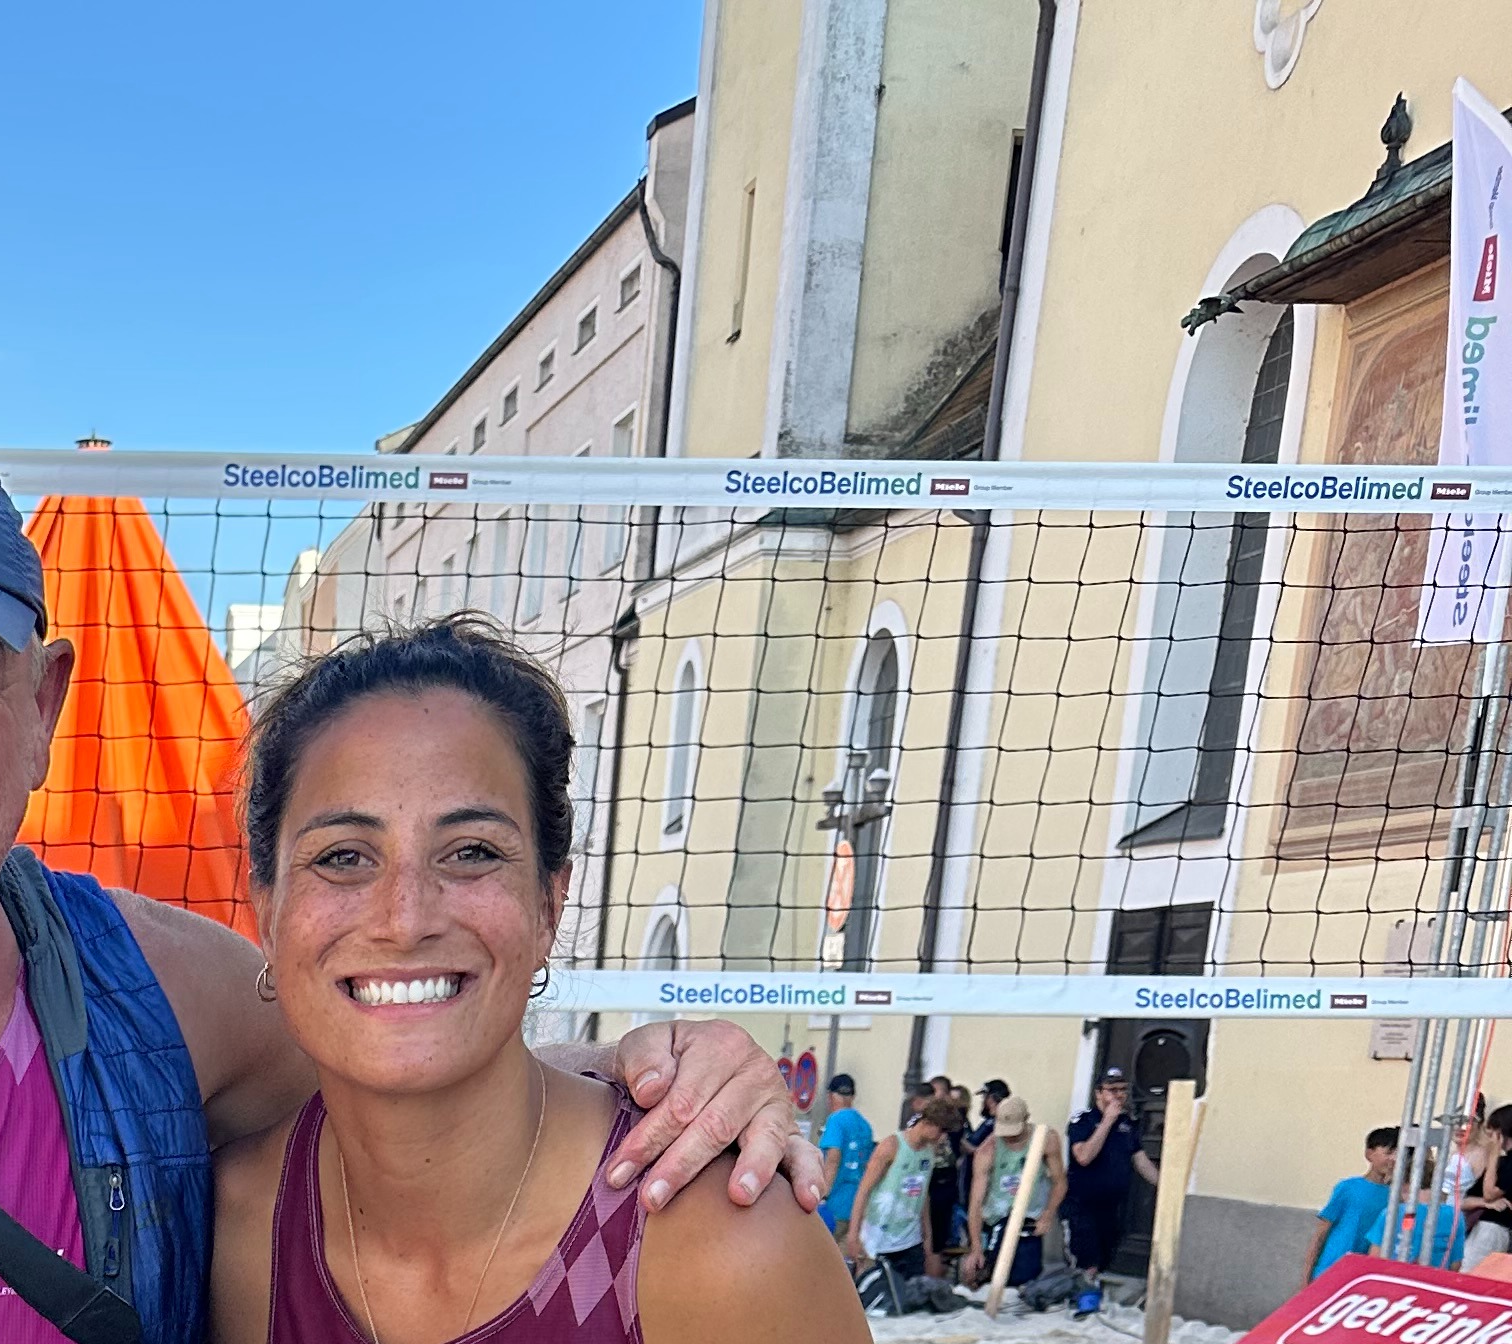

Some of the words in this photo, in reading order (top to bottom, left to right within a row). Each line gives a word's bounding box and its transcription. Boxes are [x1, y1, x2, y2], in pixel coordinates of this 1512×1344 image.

[224, 463, 420, 489] SteelcoBelimed
[725, 469, 923, 496] SteelcoBelimed
[1225, 474, 1425, 501] SteelcoBelimed
[659, 982, 846, 1006] SteelcoBelimed
[1135, 987, 1322, 1010] SteelcoBelimed
